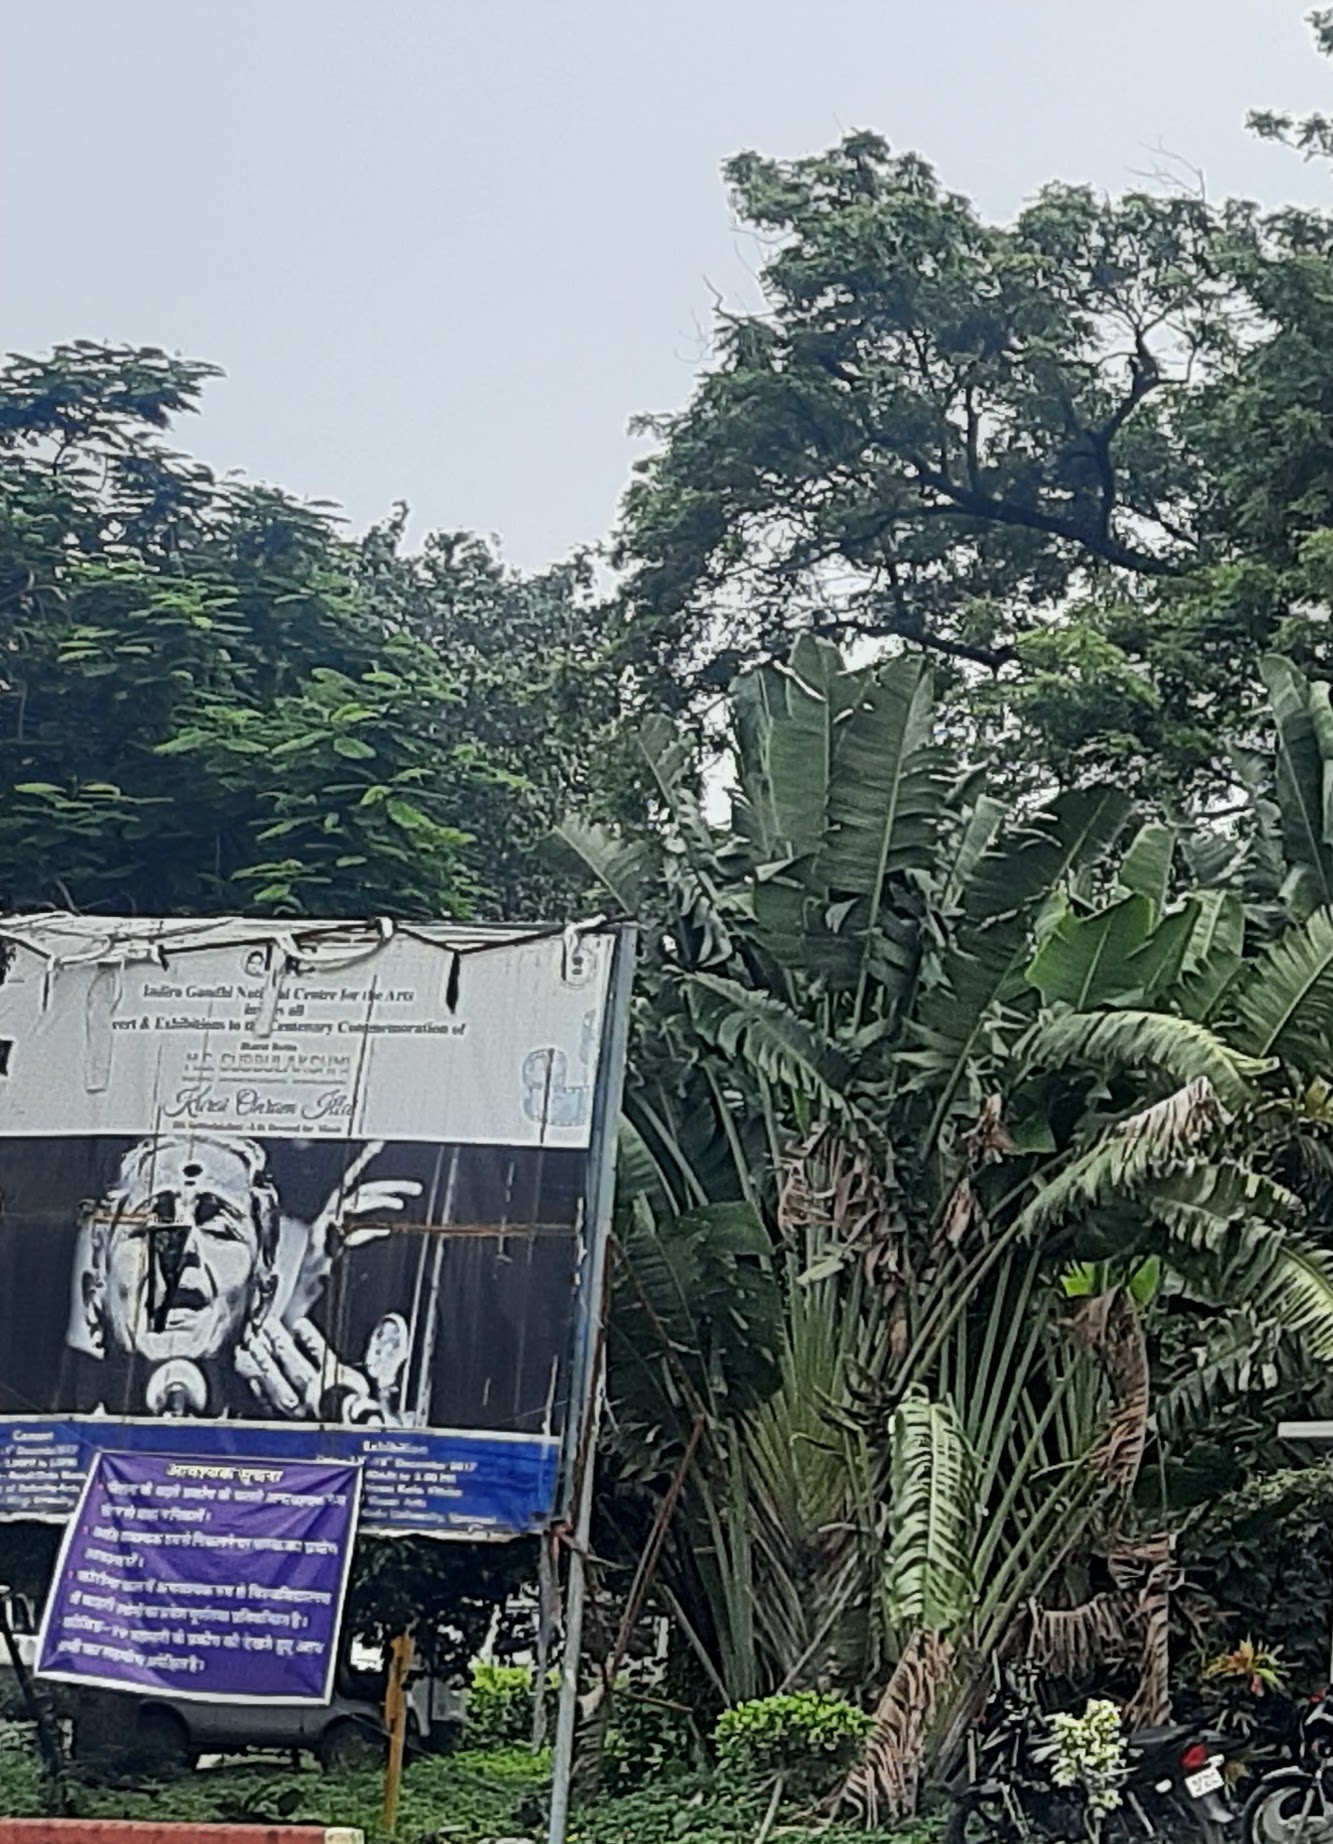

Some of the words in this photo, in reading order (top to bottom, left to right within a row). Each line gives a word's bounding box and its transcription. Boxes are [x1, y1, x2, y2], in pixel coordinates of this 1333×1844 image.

[186, 985, 232, 998] Gandhi
[237, 985, 289, 999] Natial
[294, 987, 337, 1000] Centre
[386, 990, 415, 1001] Arts
